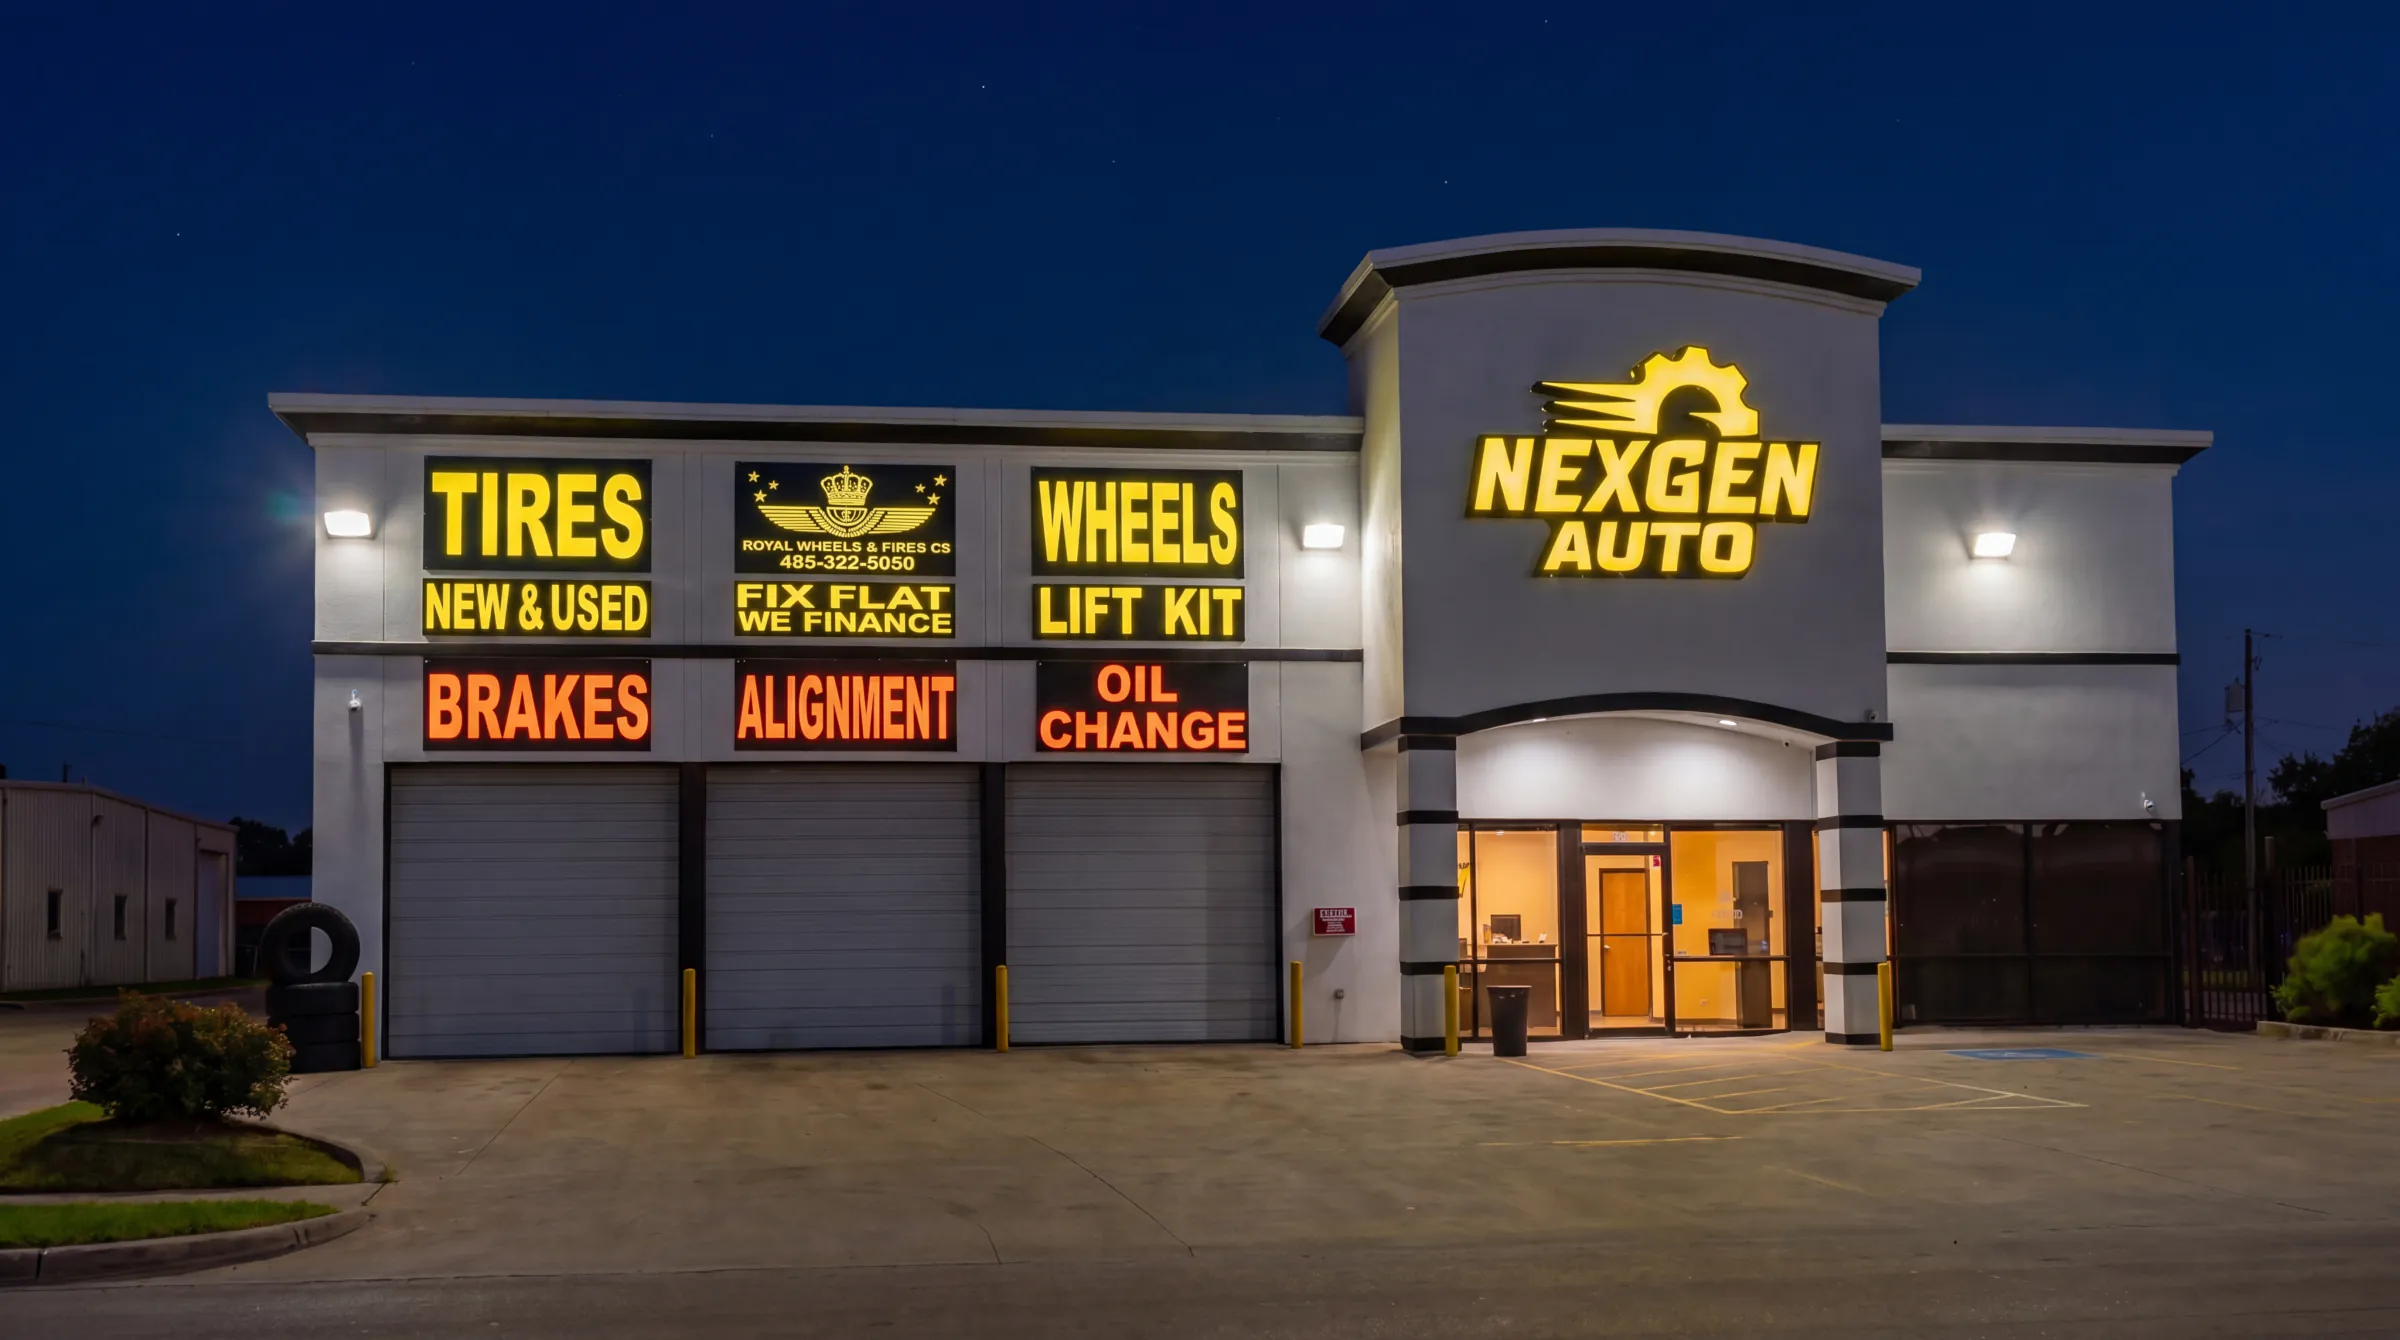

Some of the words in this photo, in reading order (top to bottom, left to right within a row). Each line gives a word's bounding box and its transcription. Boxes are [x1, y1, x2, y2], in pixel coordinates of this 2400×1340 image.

[1474, 436, 1819, 517] NEXGEN
[432, 472, 643, 559] TIRES
[1038, 480, 1237, 565] WHEELS
[742, 540, 793, 552] ROYAL
[797, 541, 862, 553] WHEELS
[867, 542, 878, 553] &
[882, 542, 926, 554] FIRES
[931, 543, 951, 554] CS
[780, 555, 915, 571] 485-322-5050
[1543, 520, 1753, 573] AUTO
[426, 583, 510, 630] NEW
[518, 584, 544, 630] &
[552, 584, 648, 631] USED
[737, 584, 815, 608] FIX
[830, 585, 950, 610] FLAT
[1040, 587, 1142, 634] LIFT
[1165, 588, 1242, 635] KIT
[738, 611, 792, 631] WE
[804, 612, 952, 633] FINANCE
[429, 673, 649, 740] BRAKES
[737, 674, 954, 740] ALIGNMENT
[1097, 664, 1178, 702] OIL
[1040, 710, 1246, 749] CHANGE
